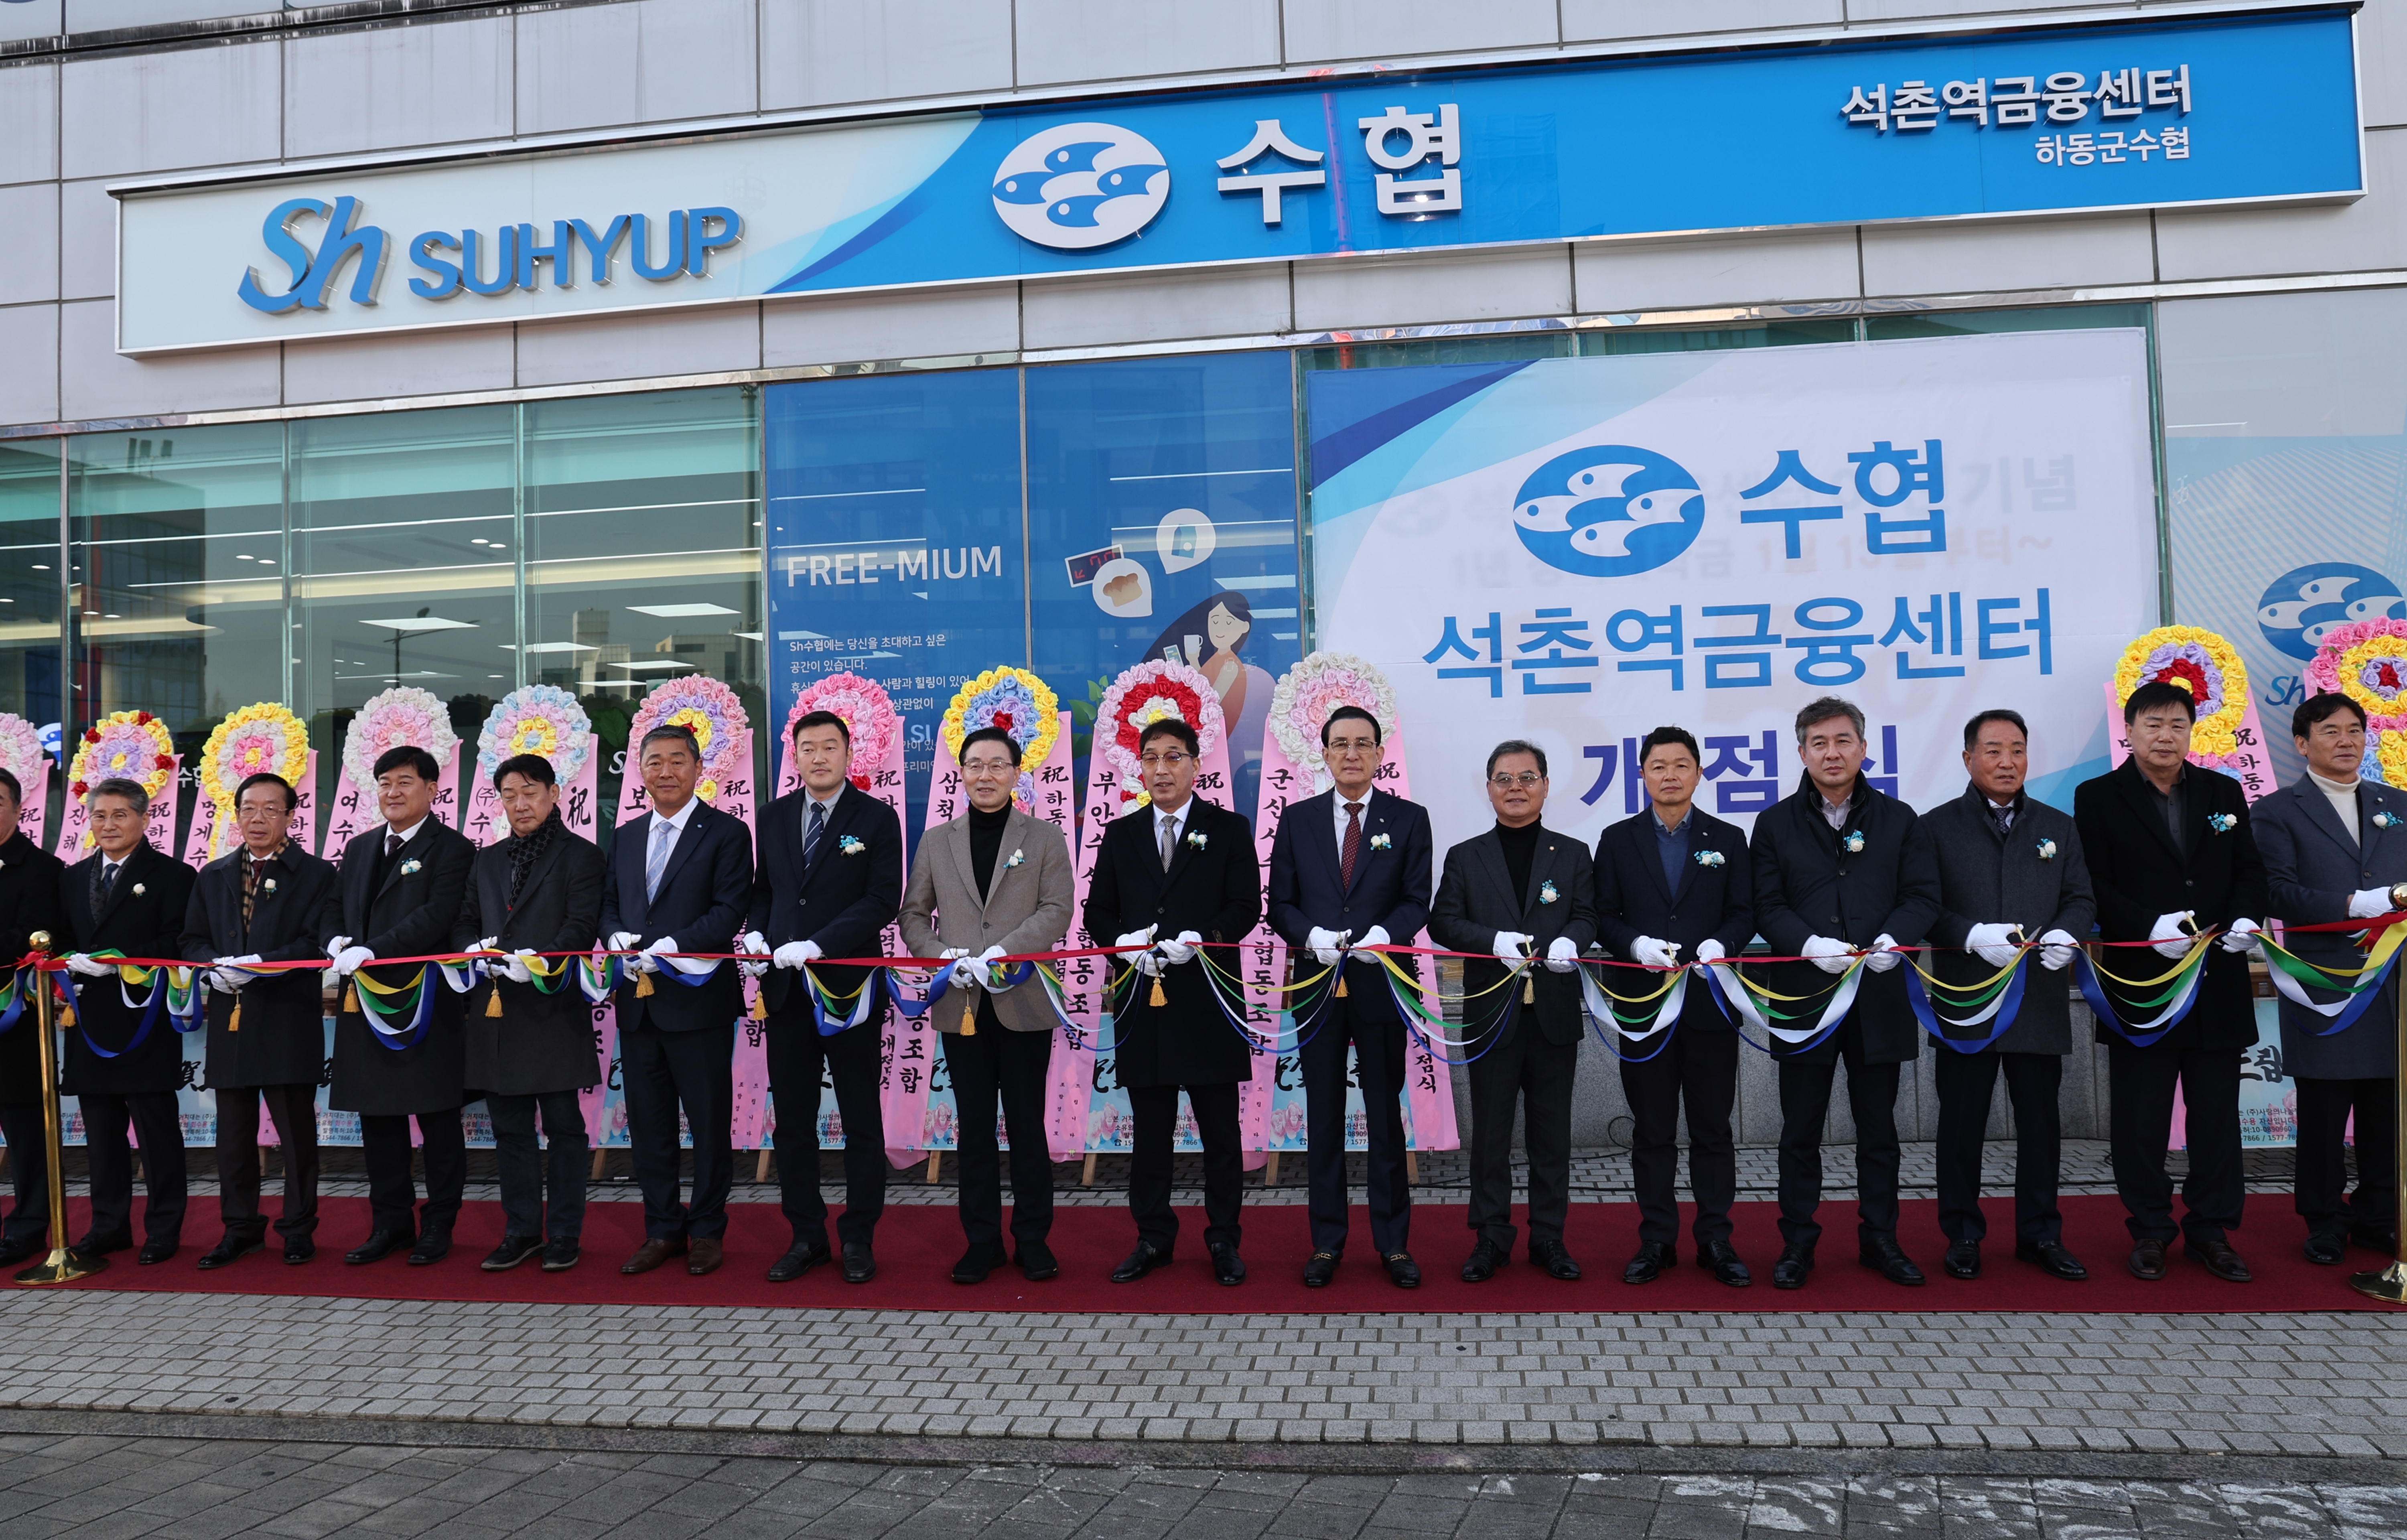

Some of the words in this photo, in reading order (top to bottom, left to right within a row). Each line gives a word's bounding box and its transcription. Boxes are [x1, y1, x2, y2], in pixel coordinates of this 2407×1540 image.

[1841, 63, 2192, 133] 석촌역금융센터
[2035, 126, 2190, 166] 하동군수협
[1216, 103, 1462, 229] 수협
[237, 195, 390, 314] Sh
[408, 206, 743, 301] SUHYUP
[1739, 438, 1947, 559] 수협
[787, 546, 1001, 587] FREE-MIUM
[790, 638, 844, 652] Sh수협에는
[847, 637, 878, 650] 당신을
[881, 635, 922, 648] 초대하고
[925, 633, 946, 647] 싶은
[1423, 587, 2053, 698] 석촌역금융센터
[790, 661, 820, 674] 공간이
[824, 659, 867, 672] 있습니다.
[791, 682, 816, 694] 휴식
[882, 676, 912, 690] 사람과
[915, 675, 946, 688] 힐링이
[2265, 676, 2305, 706] Sh
[893, 698, 934, 711] 상관없이
[873, 770, 901, 788] 祝
[1040, 766, 1070, 784] 祝
[1196, 772, 1224, 790] 祝
[1581, 725, 1900, 814] 개점
[723, 780, 750, 797] 祝
[148, 802, 170, 819] 祝
[567, 786, 592, 829] 祝
